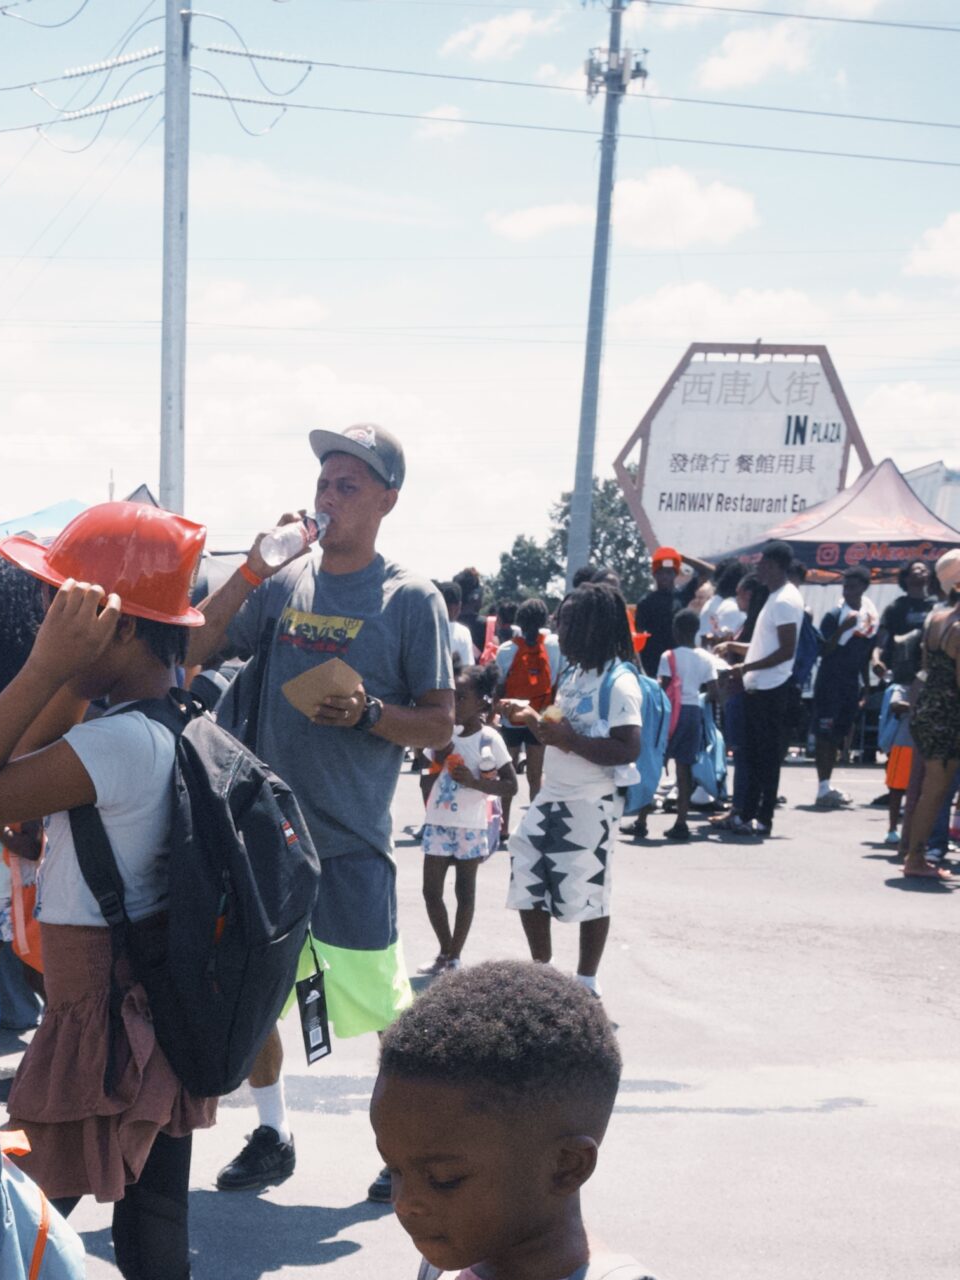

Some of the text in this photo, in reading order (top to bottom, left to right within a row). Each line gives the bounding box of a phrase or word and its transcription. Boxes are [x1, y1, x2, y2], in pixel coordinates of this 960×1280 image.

[680, 370, 821, 406] 西唐人街
[784, 415, 842, 446] IN PLAZA
[658, 492, 715, 513] FAIRWAY
[715, 492, 788, 513] Restaurant
